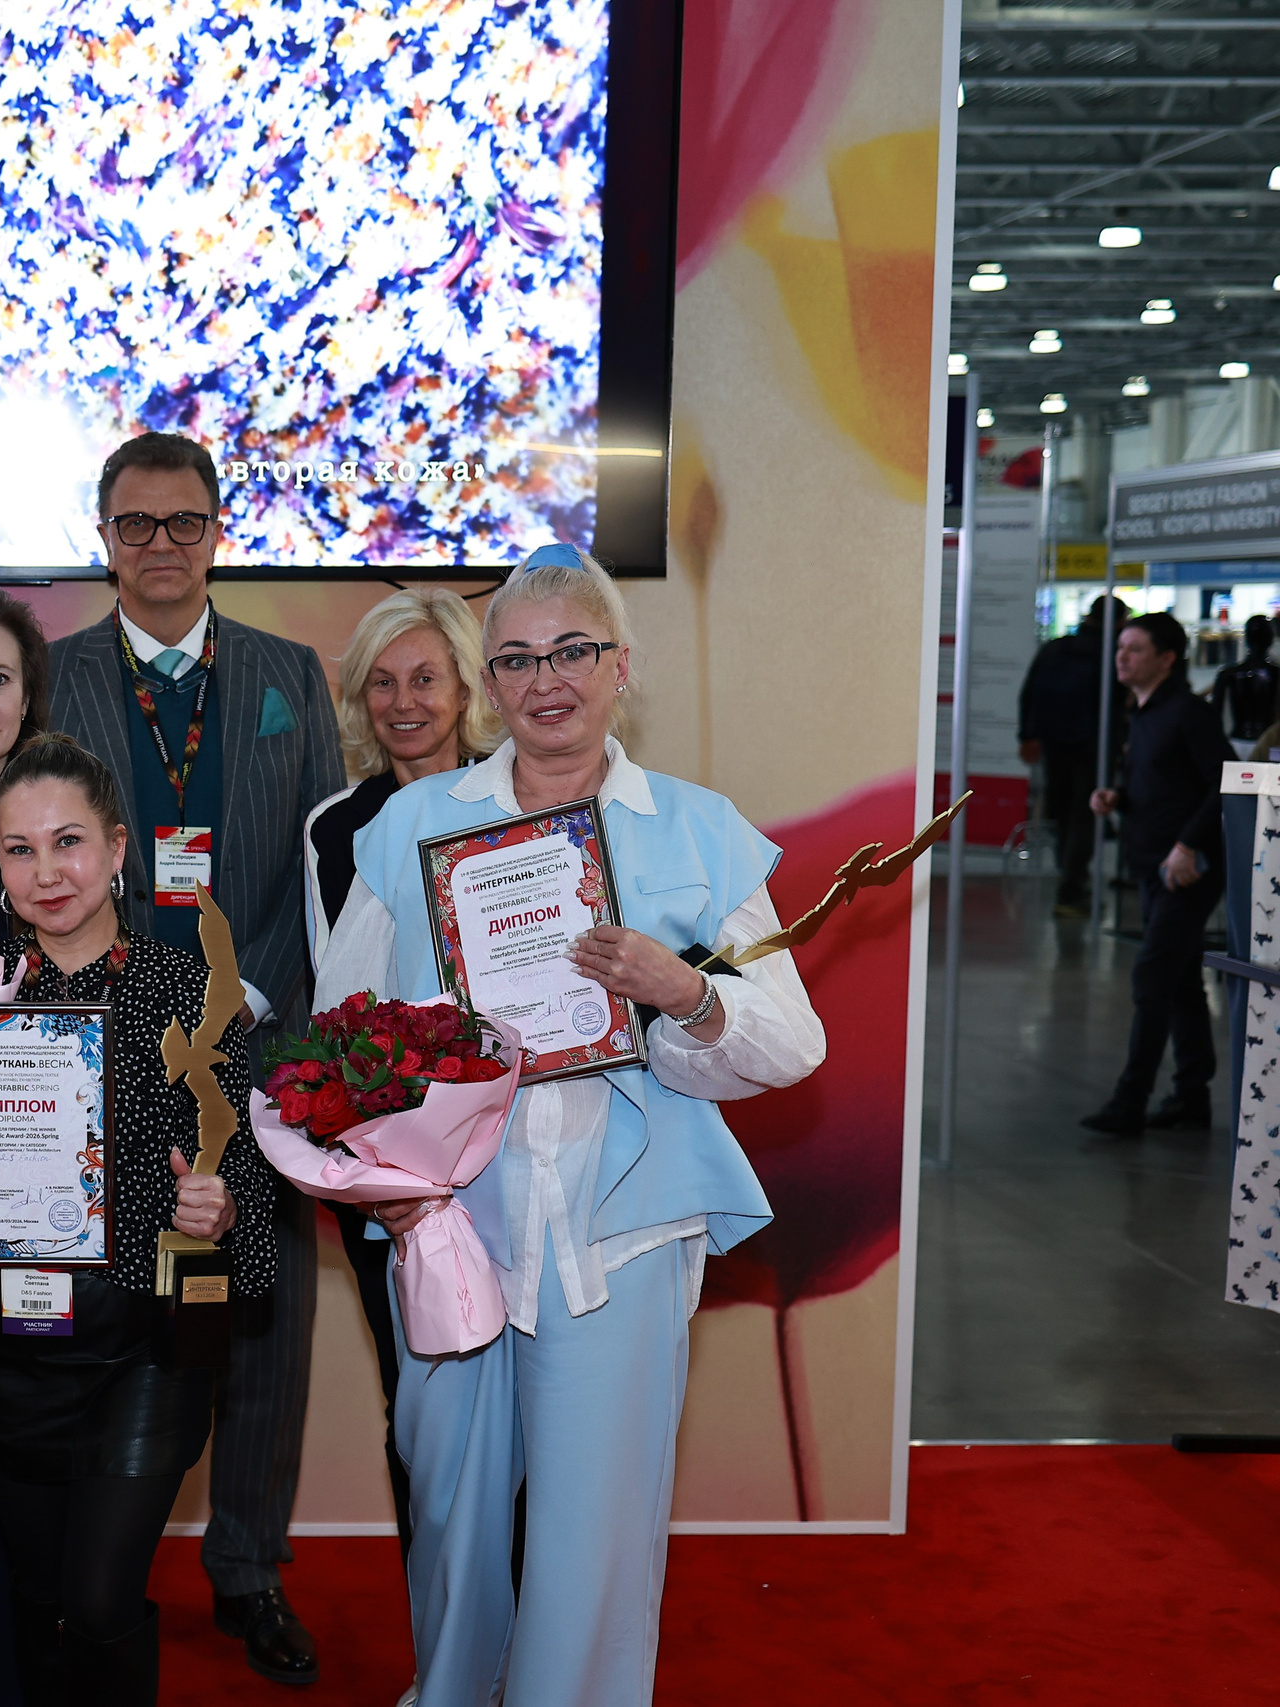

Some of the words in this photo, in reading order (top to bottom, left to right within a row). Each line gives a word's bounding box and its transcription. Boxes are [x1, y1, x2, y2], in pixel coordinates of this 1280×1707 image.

[374, 459, 485, 483] кожа»
[472, 860, 570, 892] ИНТЕРТКАНЬ.ВЕСНА
[486, 888, 561, 912] INTERFABRIC.SPRING
[489, 904, 561, 936] ДИПЛОМ
[507, 924, 543, 938] DIPLOMA
[489, 949, 517, 960] Interfabric
[517, 936, 569, 954] Award-2026.Spring
